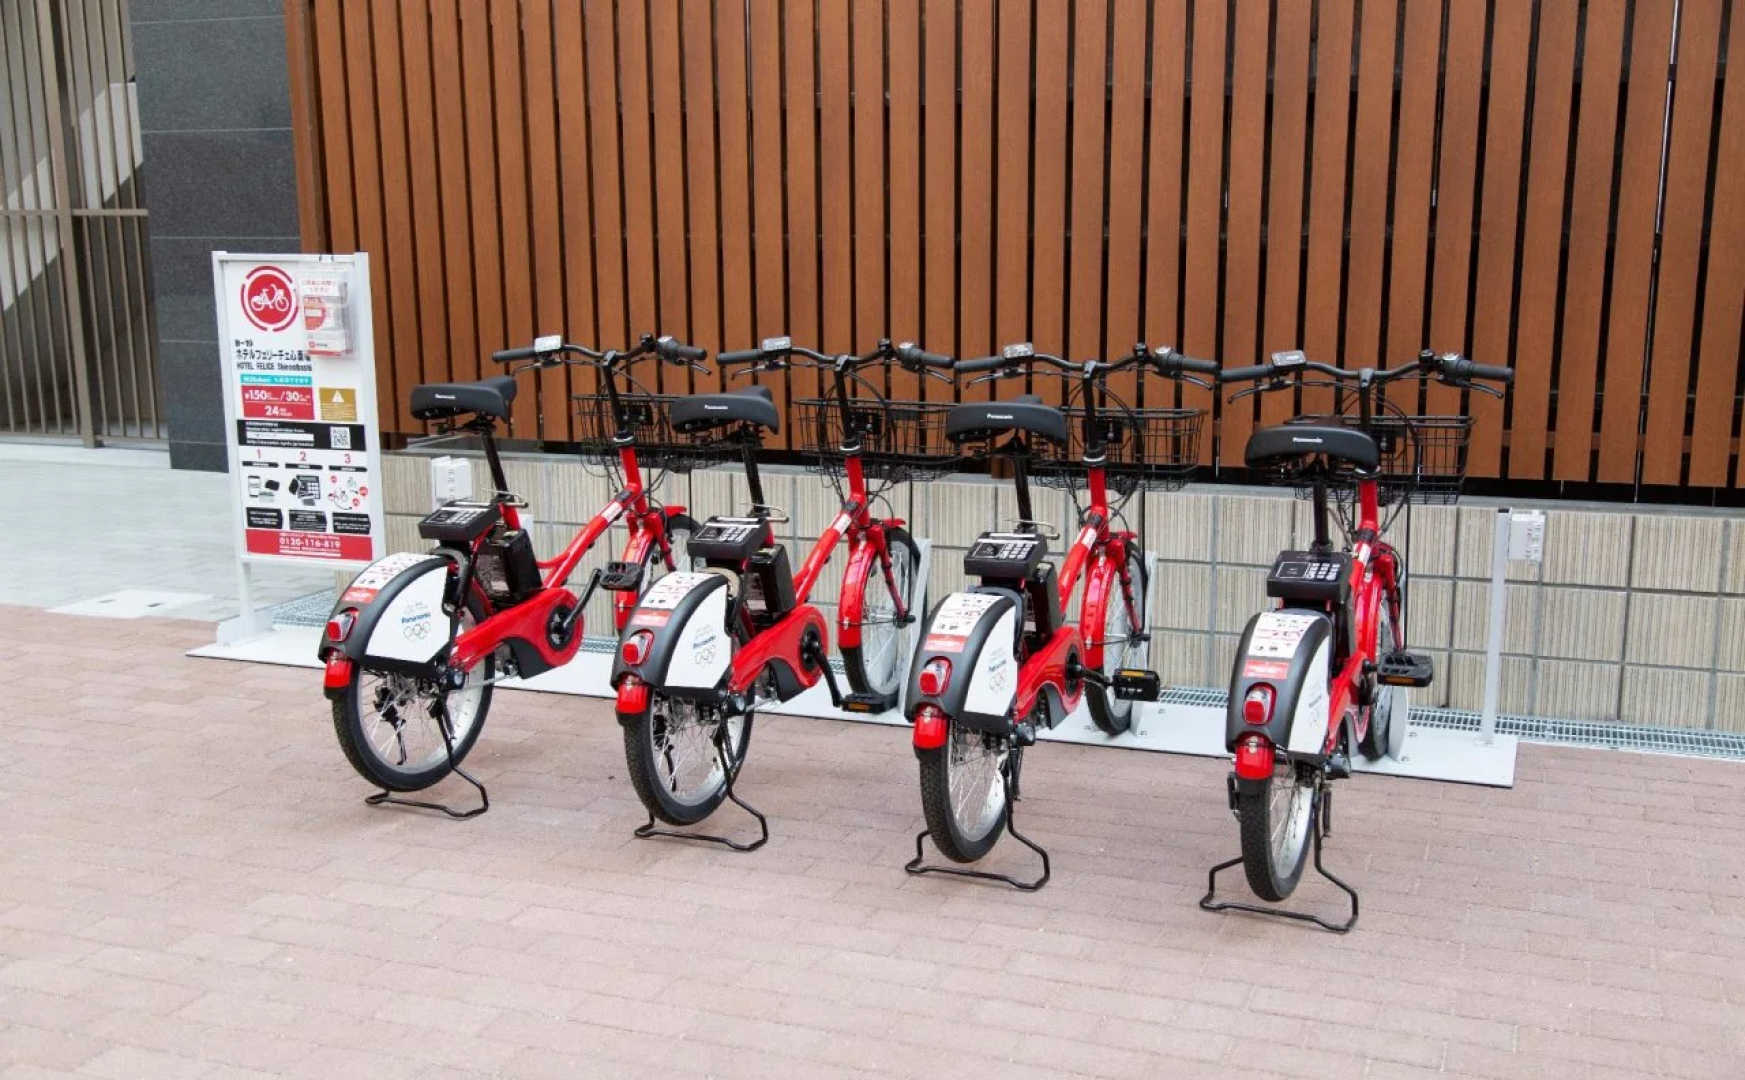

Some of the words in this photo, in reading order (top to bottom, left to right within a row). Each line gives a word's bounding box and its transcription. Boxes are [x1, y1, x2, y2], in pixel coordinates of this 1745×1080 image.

[236, 362, 254, 370] HOTEL
[265, 405, 279, 416] 24
[256, 449, 261, 459] 1
[300, 451, 307, 462] 2
[344, 453, 351, 464] 3
[279, 537, 341, 548] 0120-116-819
[401, 611, 432, 623] Panasonic
